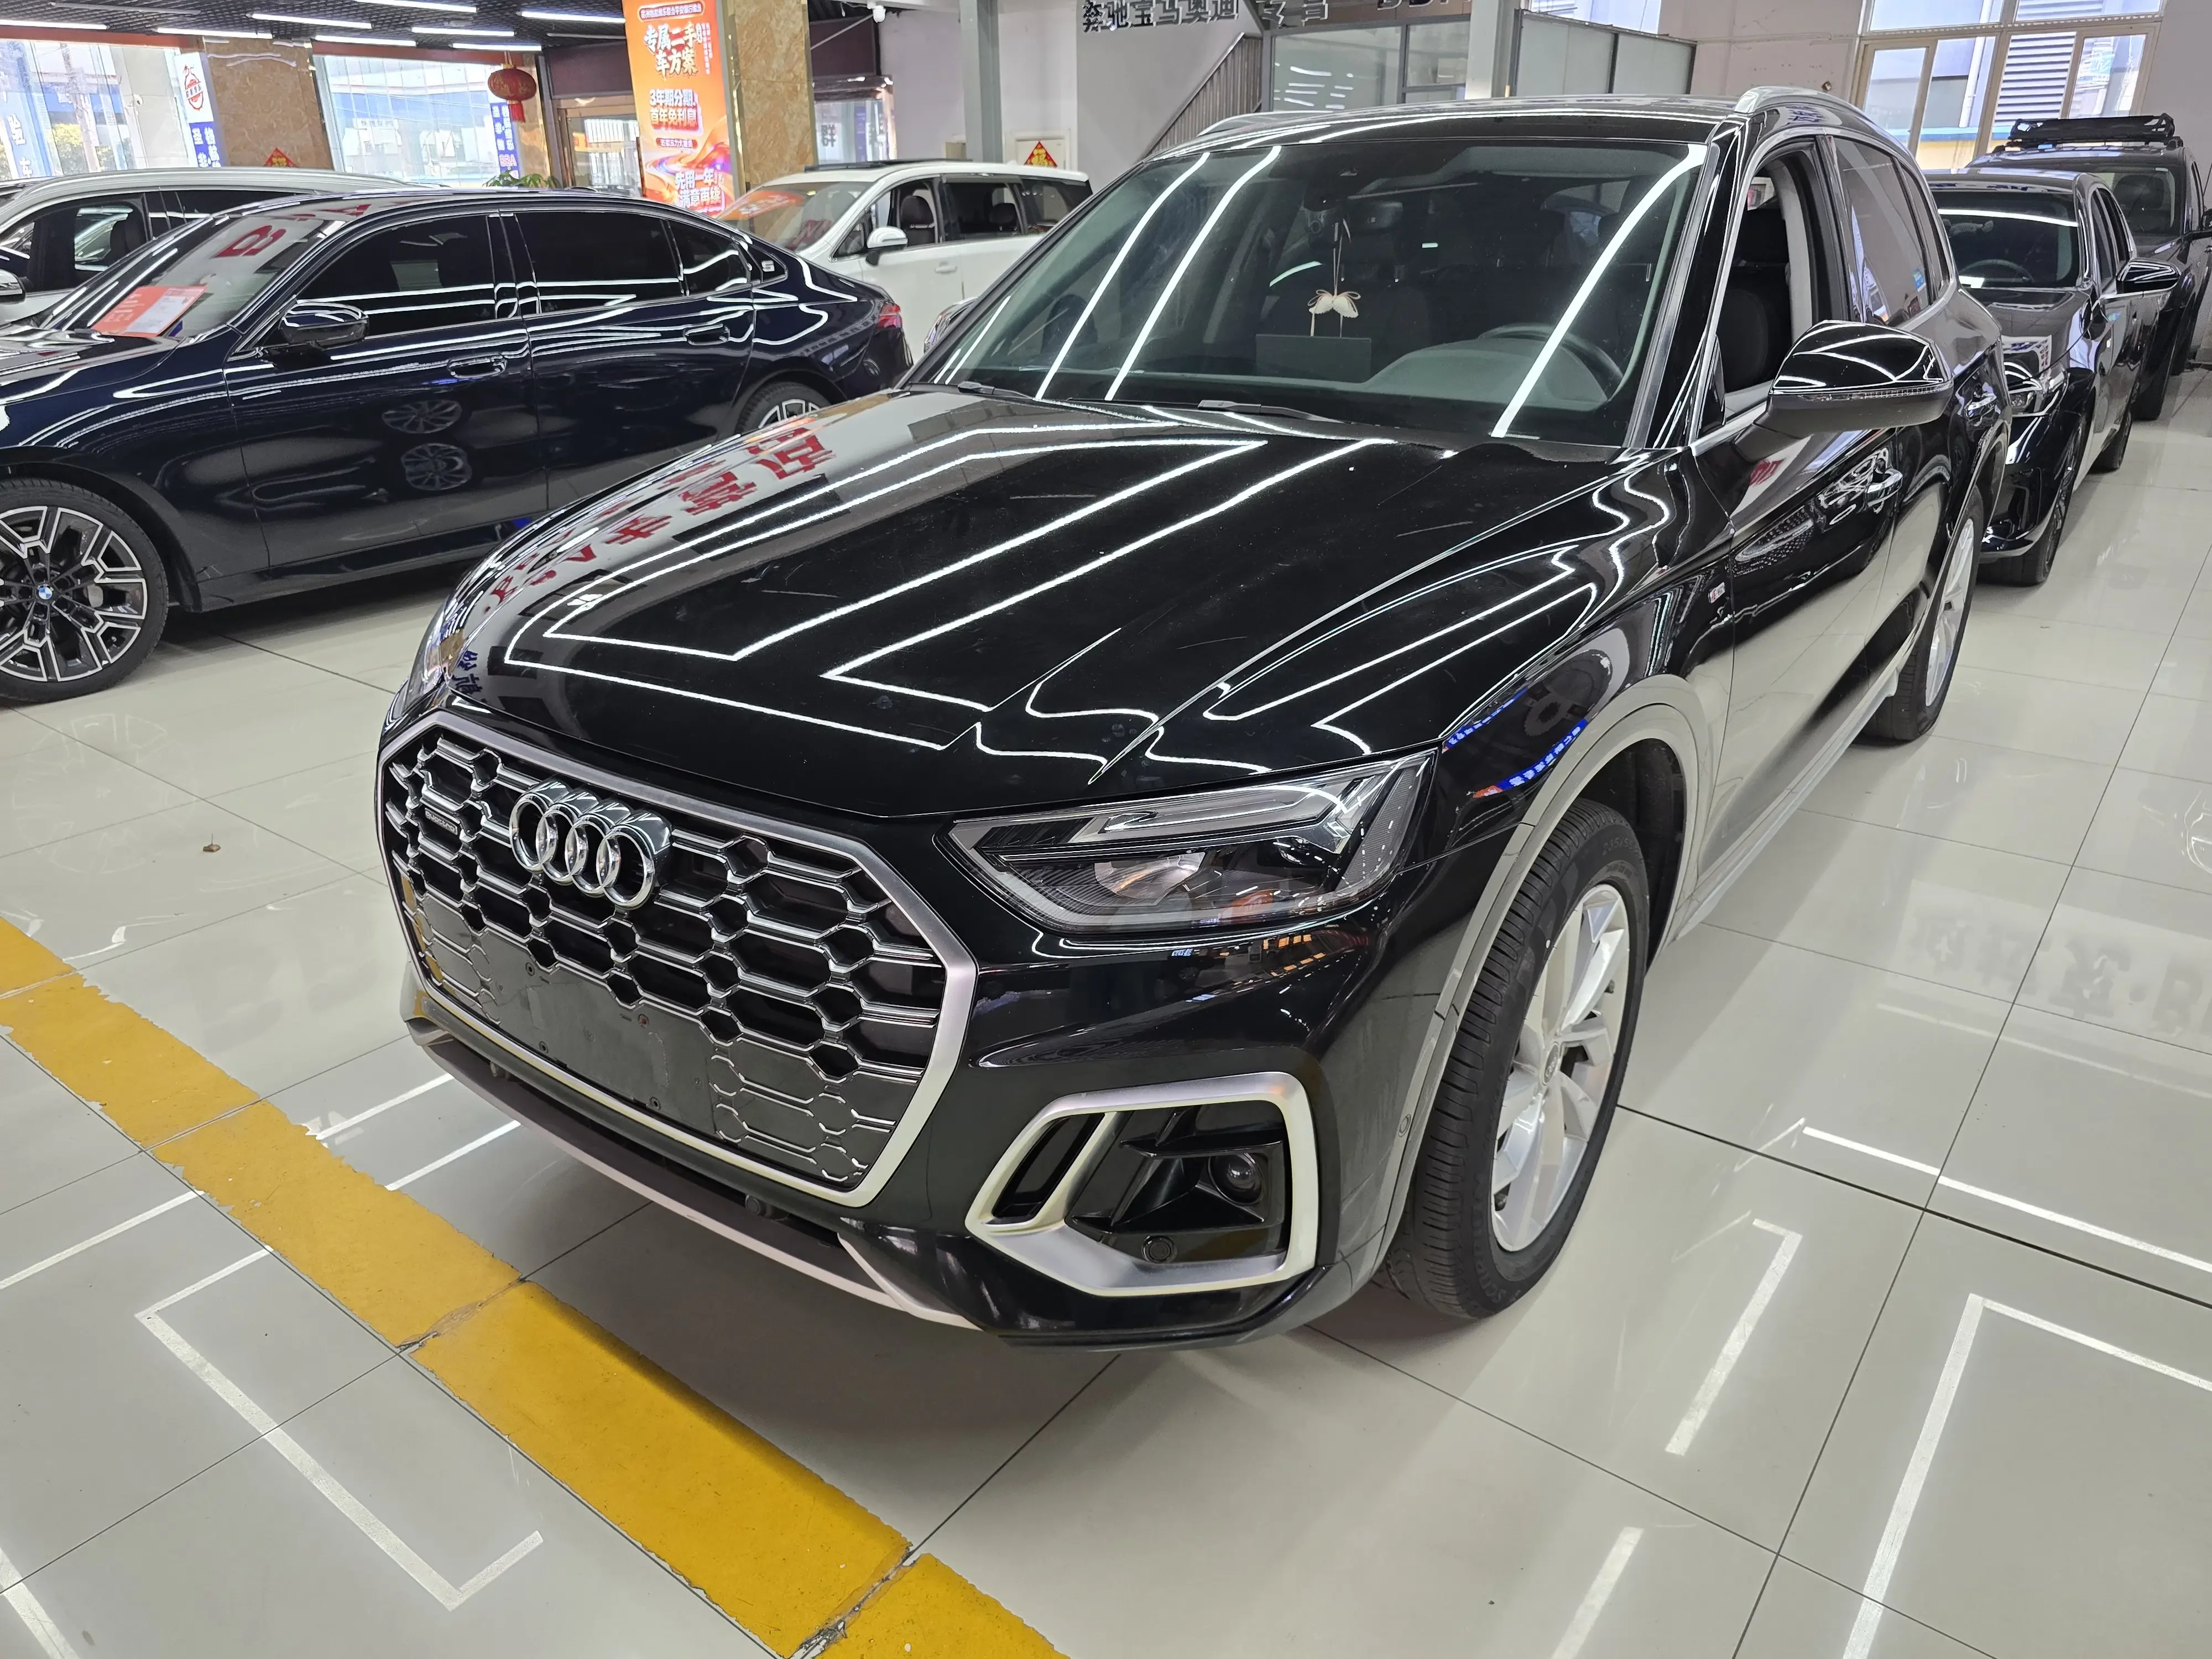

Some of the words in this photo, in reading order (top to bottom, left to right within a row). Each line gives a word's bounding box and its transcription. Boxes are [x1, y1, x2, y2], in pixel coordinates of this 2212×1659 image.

[644, 21, 697, 54] 专属二手
[655, 46, 698, 81] 车方案
[650, 108, 698, 127] 首年免利息
